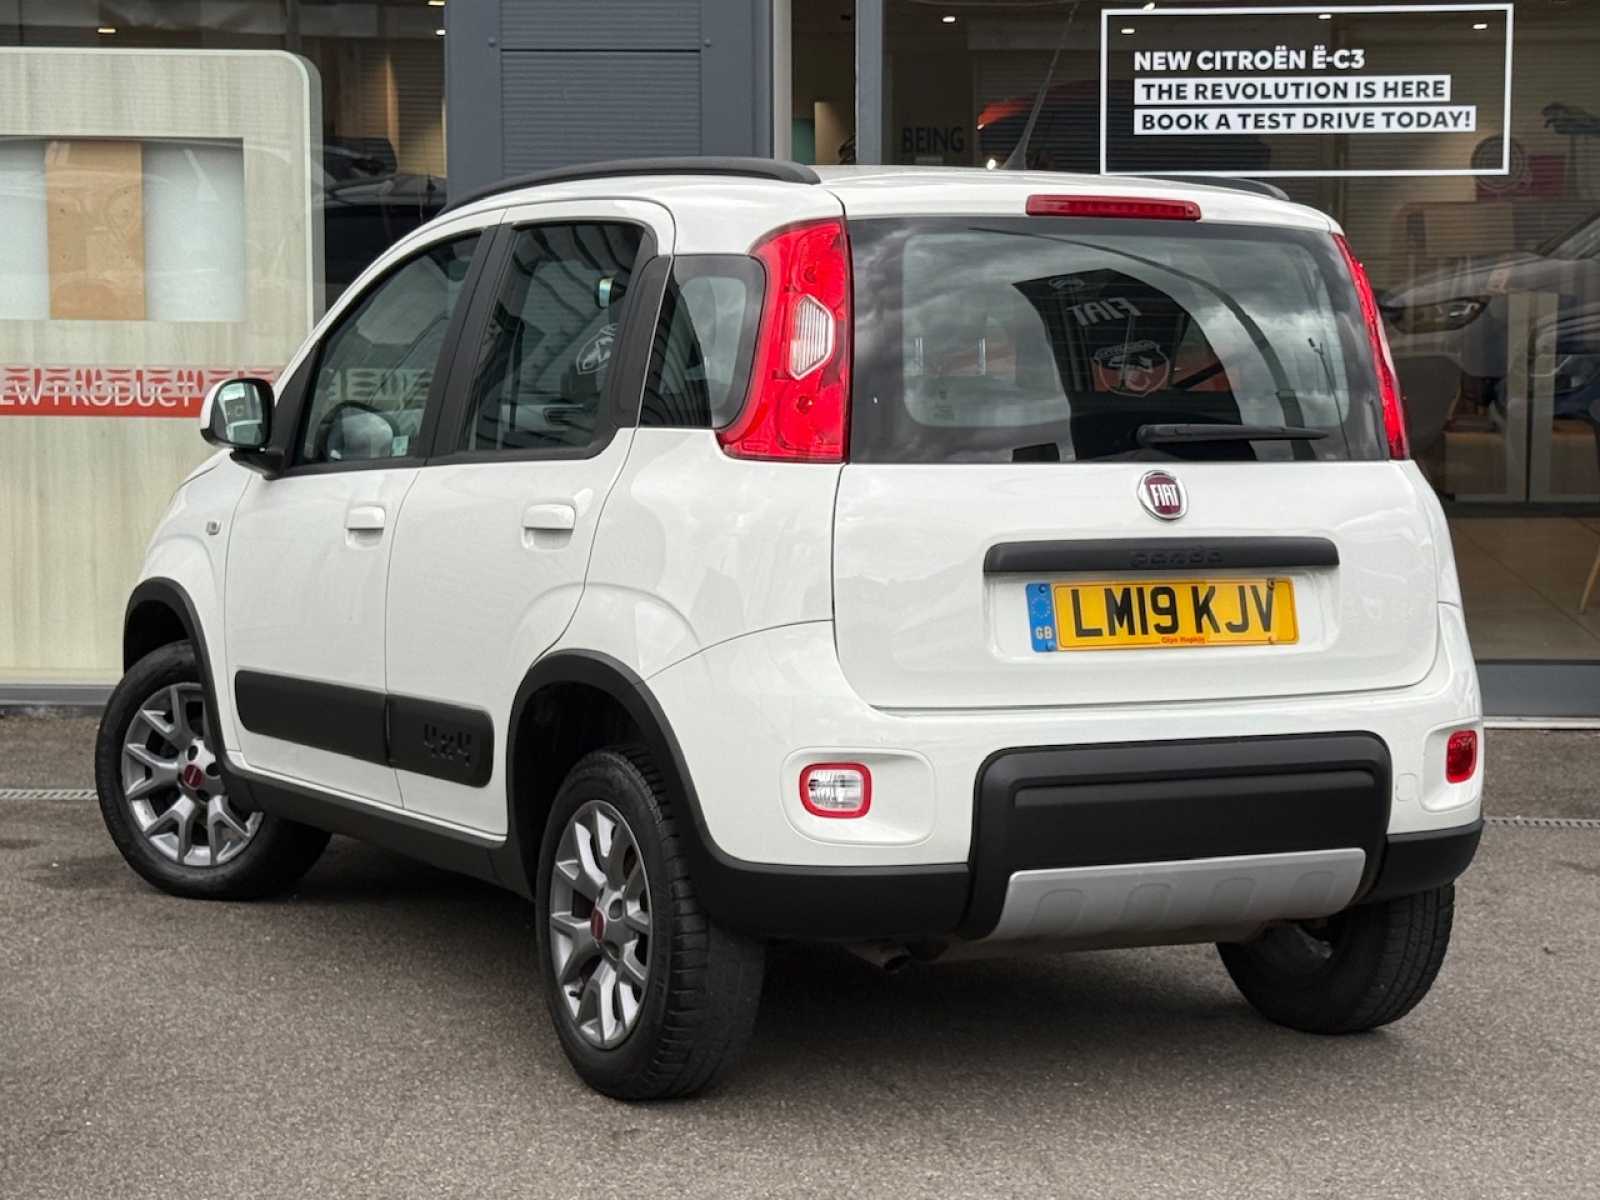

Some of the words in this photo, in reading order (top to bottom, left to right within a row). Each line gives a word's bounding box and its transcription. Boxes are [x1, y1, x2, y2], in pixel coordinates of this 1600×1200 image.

[1134, 51, 1191, 71] NEW
[1197, 45, 1306, 70] CITROËN
[1312, 45, 1365, 69] Ë-C3
[1142, 83, 1188, 101] THE
[1194, 82, 1347, 100] REVOLUTION
[1355, 82, 1376, 99] IS
[1383, 80, 1445, 98] HERE
[1141, 112, 1207, 131] BOOK
[1214, 112, 1232, 130] A
[1237, 112, 1296, 130] TEST
[1302, 112, 1375, 130] DRIVE
[1381, 110, 1471, 129] TODAY!
[901, 127, 964, 153] BEING
[53, 380, 193, 408] PRODUCT
[1150, 484, 1180, 507] FIAT
[1070, 586, 1179, 637] LM19
[1193, 585, 1275, 634] KJV
[1035, 625, 1053, 641] GB
